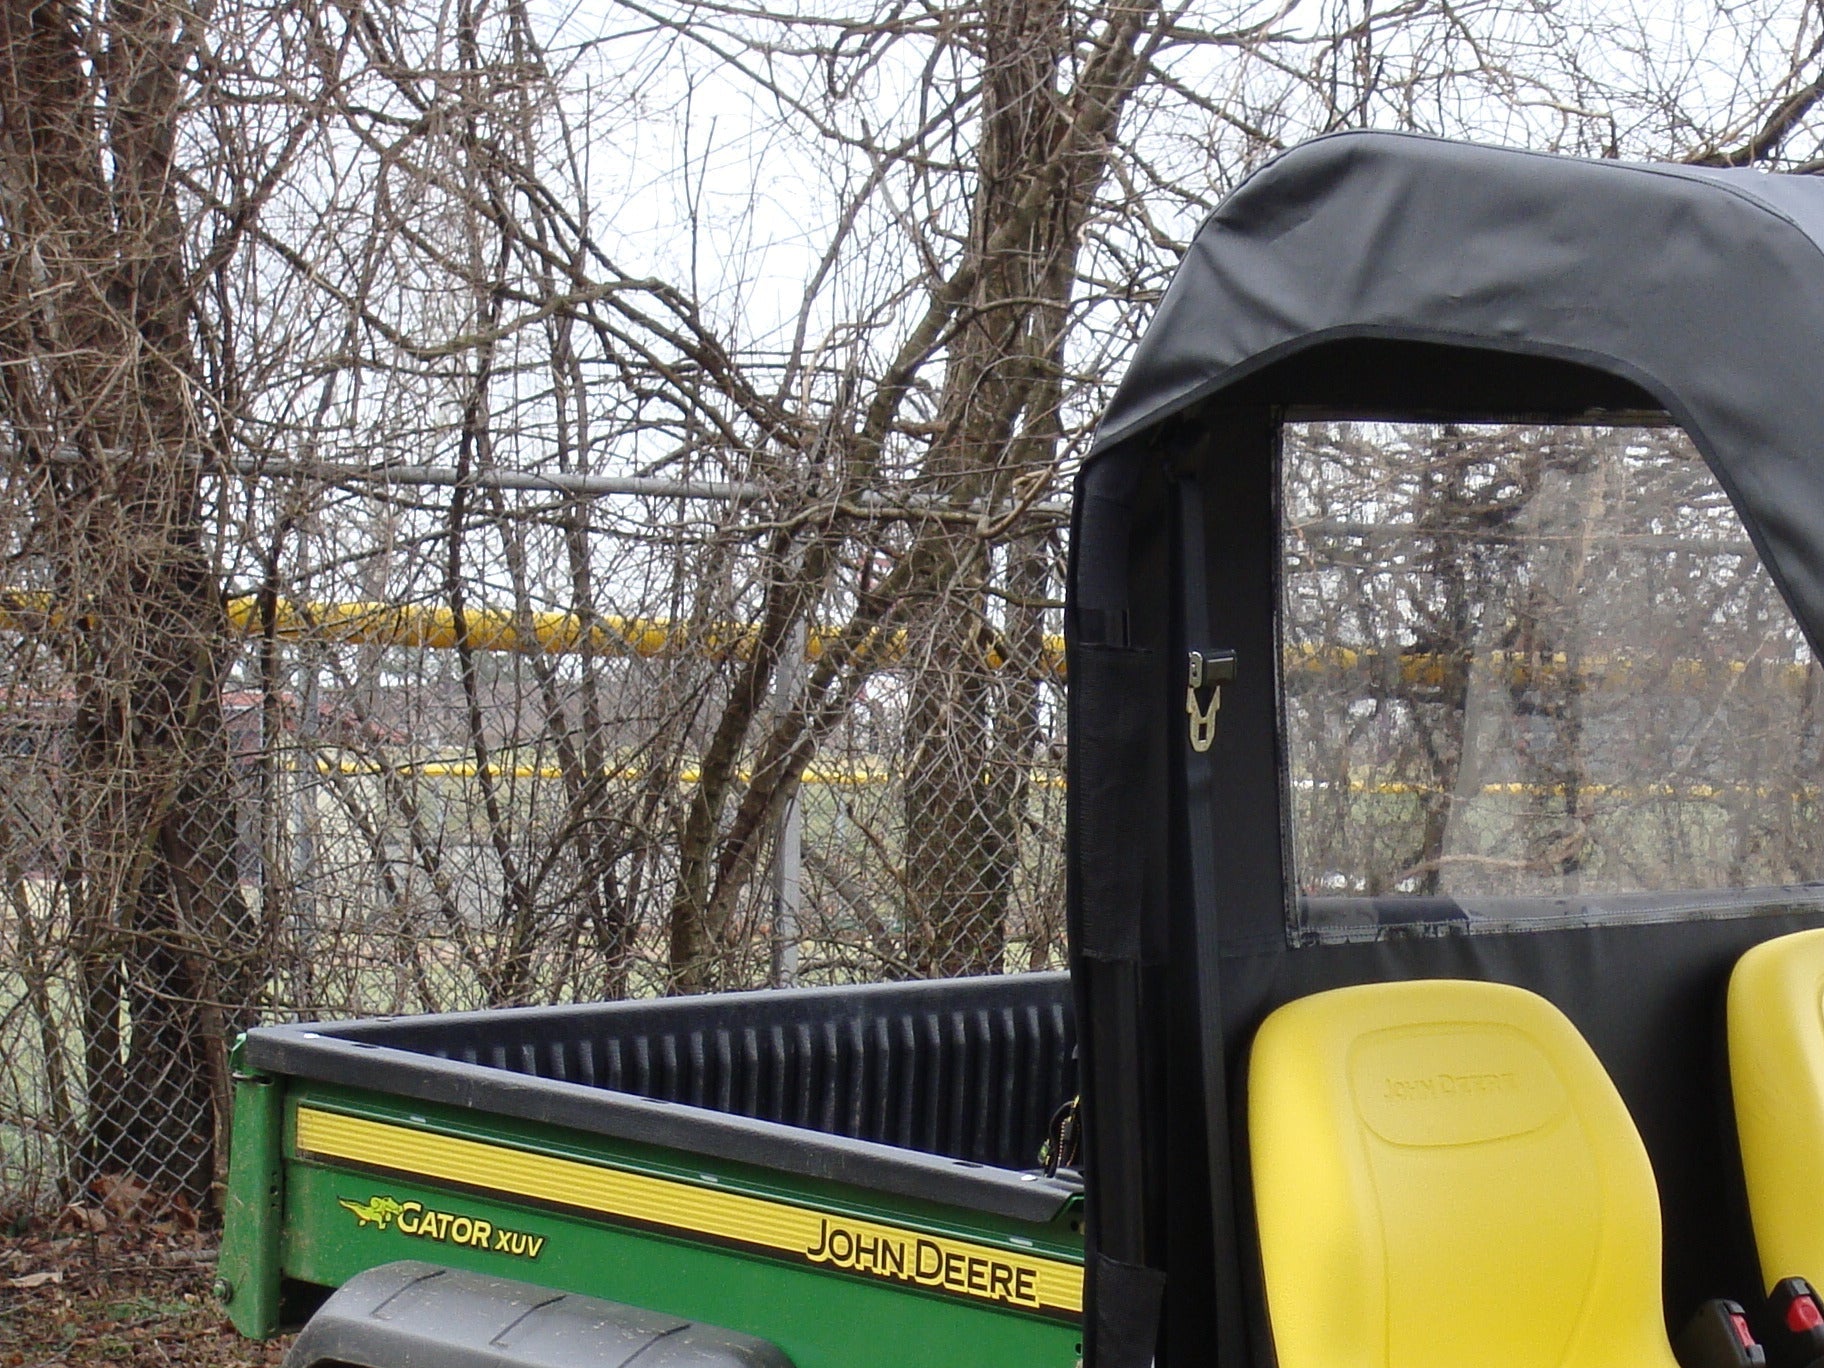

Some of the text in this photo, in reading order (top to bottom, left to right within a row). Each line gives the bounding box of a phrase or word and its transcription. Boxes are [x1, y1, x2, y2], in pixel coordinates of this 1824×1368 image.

[1382, 1071, 1517, 1102] JOHN DEERE
[398, 1201, 544, 1258] GATOR XUV
[806, 1218, 1038, 1302] JOHN DEERE
